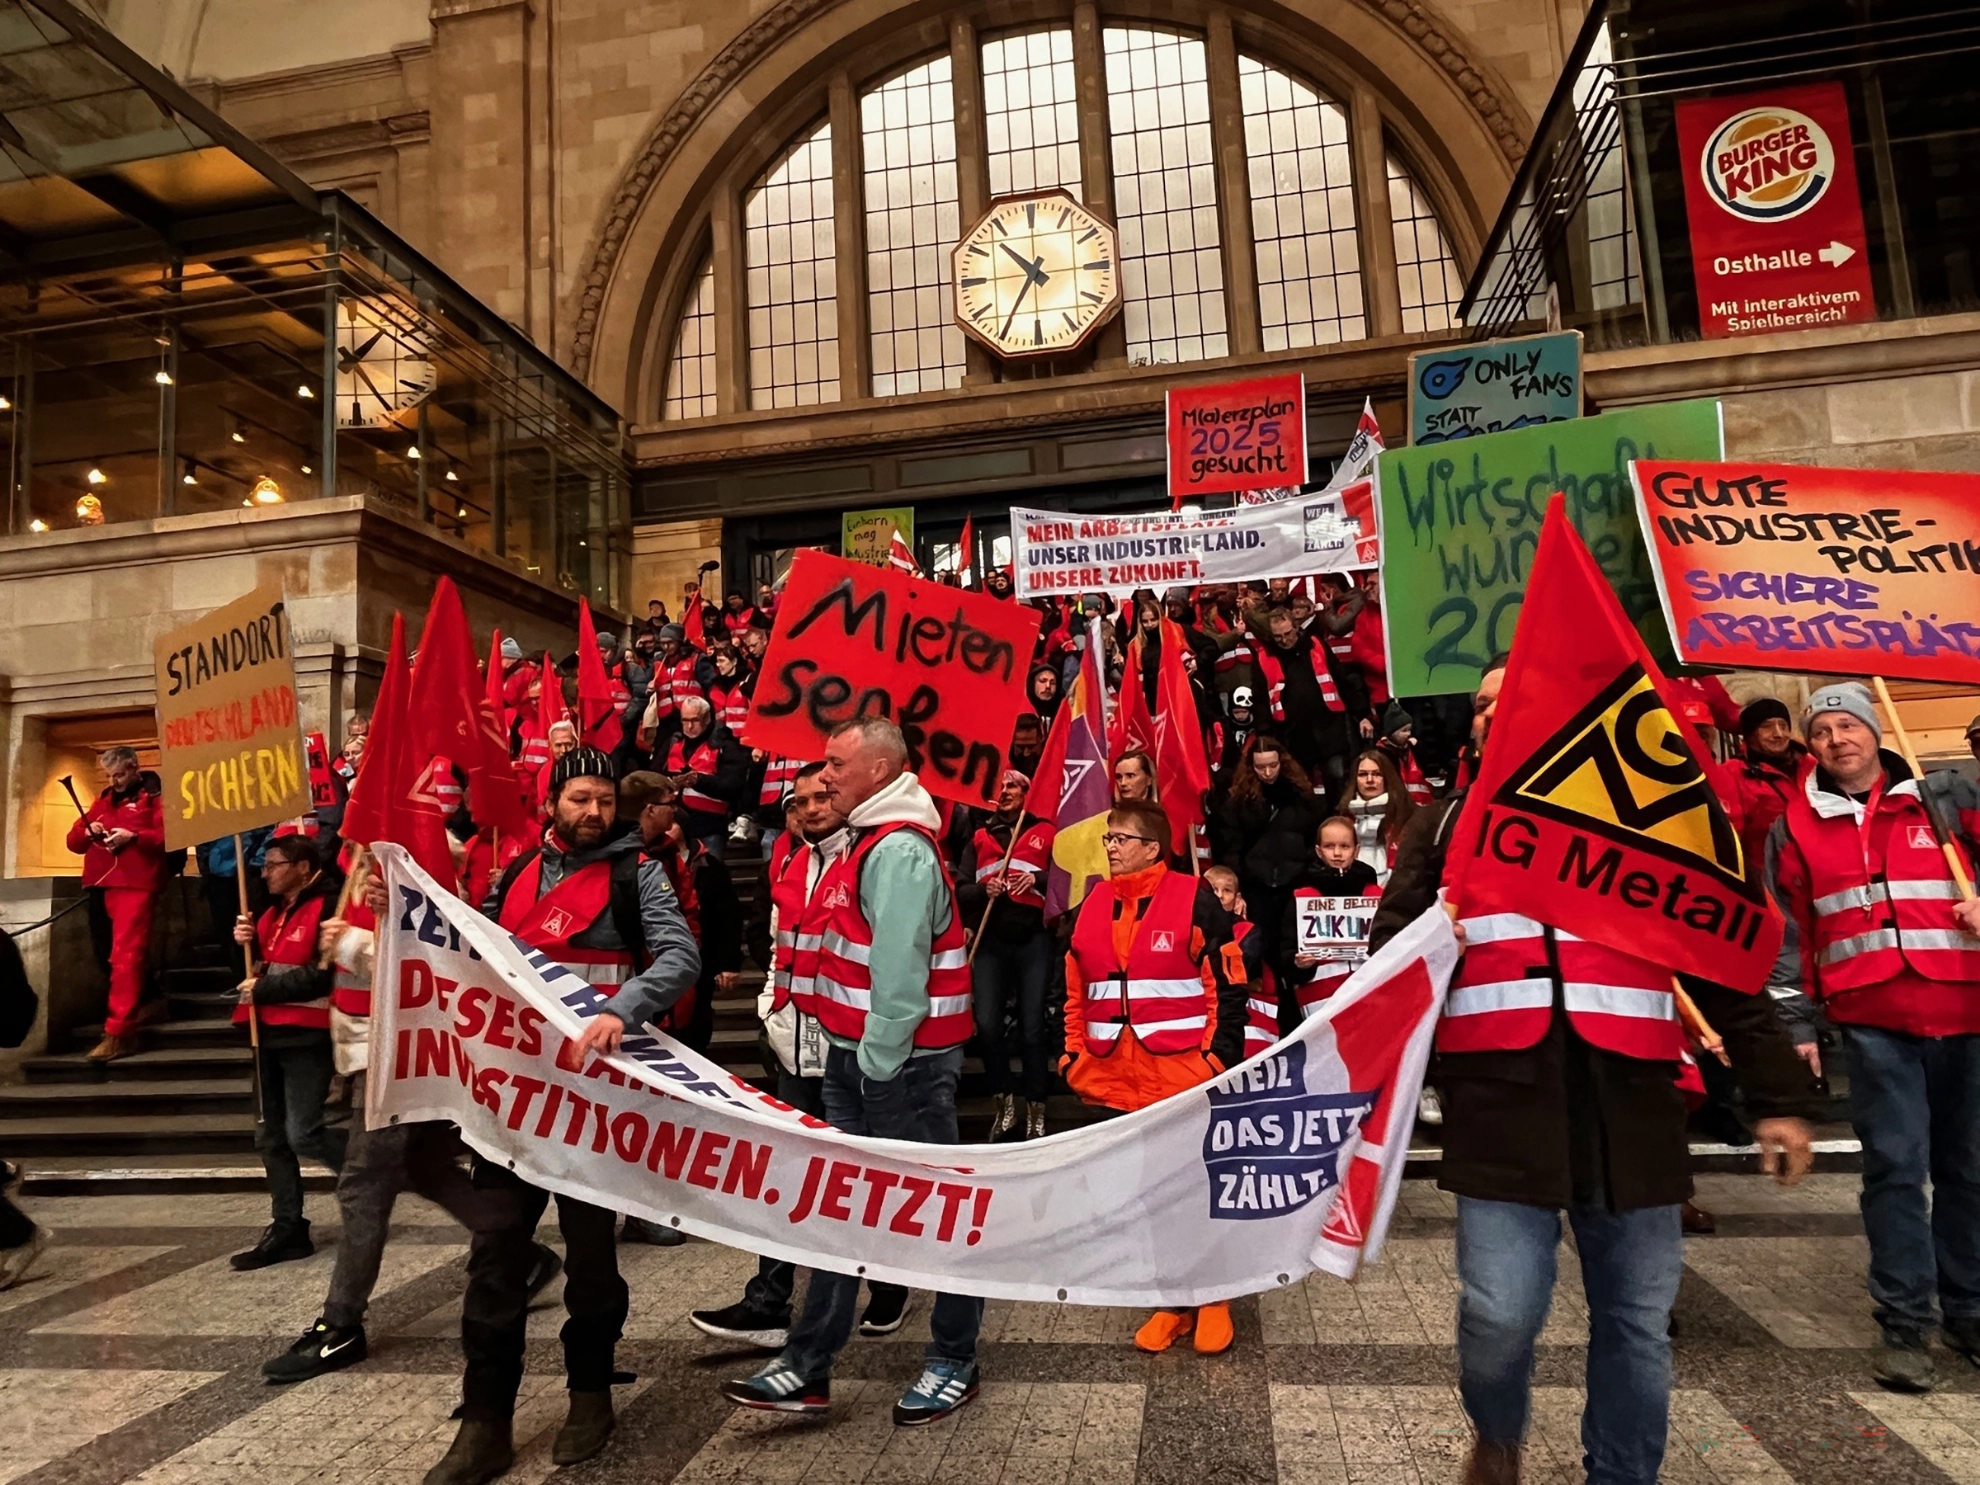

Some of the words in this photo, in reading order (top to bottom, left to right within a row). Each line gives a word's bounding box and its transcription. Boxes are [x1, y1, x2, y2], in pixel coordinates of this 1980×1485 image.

[1718, 124, 1810, 175] BURGER
[1724, 142, 1817, 202] KING
[1714, 250, 1812, 275] Osthalle
[1711, 303, 1738, 317] Mit
[1744, 290, 1860, 312] interaktivem
[1727, 305, 1846, 331] Spielbereich!
[1475, 348, 1542, 384] ONLY
[1510, 372, 1573, 399] FANS
[1182, 396, 1295, 432] M(a)erzplan
[1425, 406, 1482, 431] STATT
[1191, 421, 1281, 455] 2025
[1189, 445, 1287, 483] gesucht
[1652, 471, 1788, 509] GUTE
[1026, 522, 1073, 544] MEIN
[1657, 509, 1936, 546] INDUSTRIE-
[1028, 546, 1089, 566] UNSER
[1029, 567, 1102, 590] UNSERE
[1108, 559, 1206, 584] ZUKUNFT.
[1684, 570, 1879, 609] SICHERE
[167, 602, 284, 695] STANDORT
[786, 577, 1013, 683] Mieten
[1684, 610, 1980, 659] ARBEITSPLÄT
[179, 739, 299, 820] SICHERN
[1474, 809, 1540, 871] IG
[1557, 834, 1764, 952] Metall
[1307, 898, 1336, 911] EINE
[1216, 1056, 1292, 1095] WEIL
[395, 1028, 782, 1207] INVSTITIONEN.
[789, 1156, 994, 1247] JETZT!
[1212, 1114, 1284, 1152] DAS
[1218, 1165, 1329, 1210] ZÄHLT.
